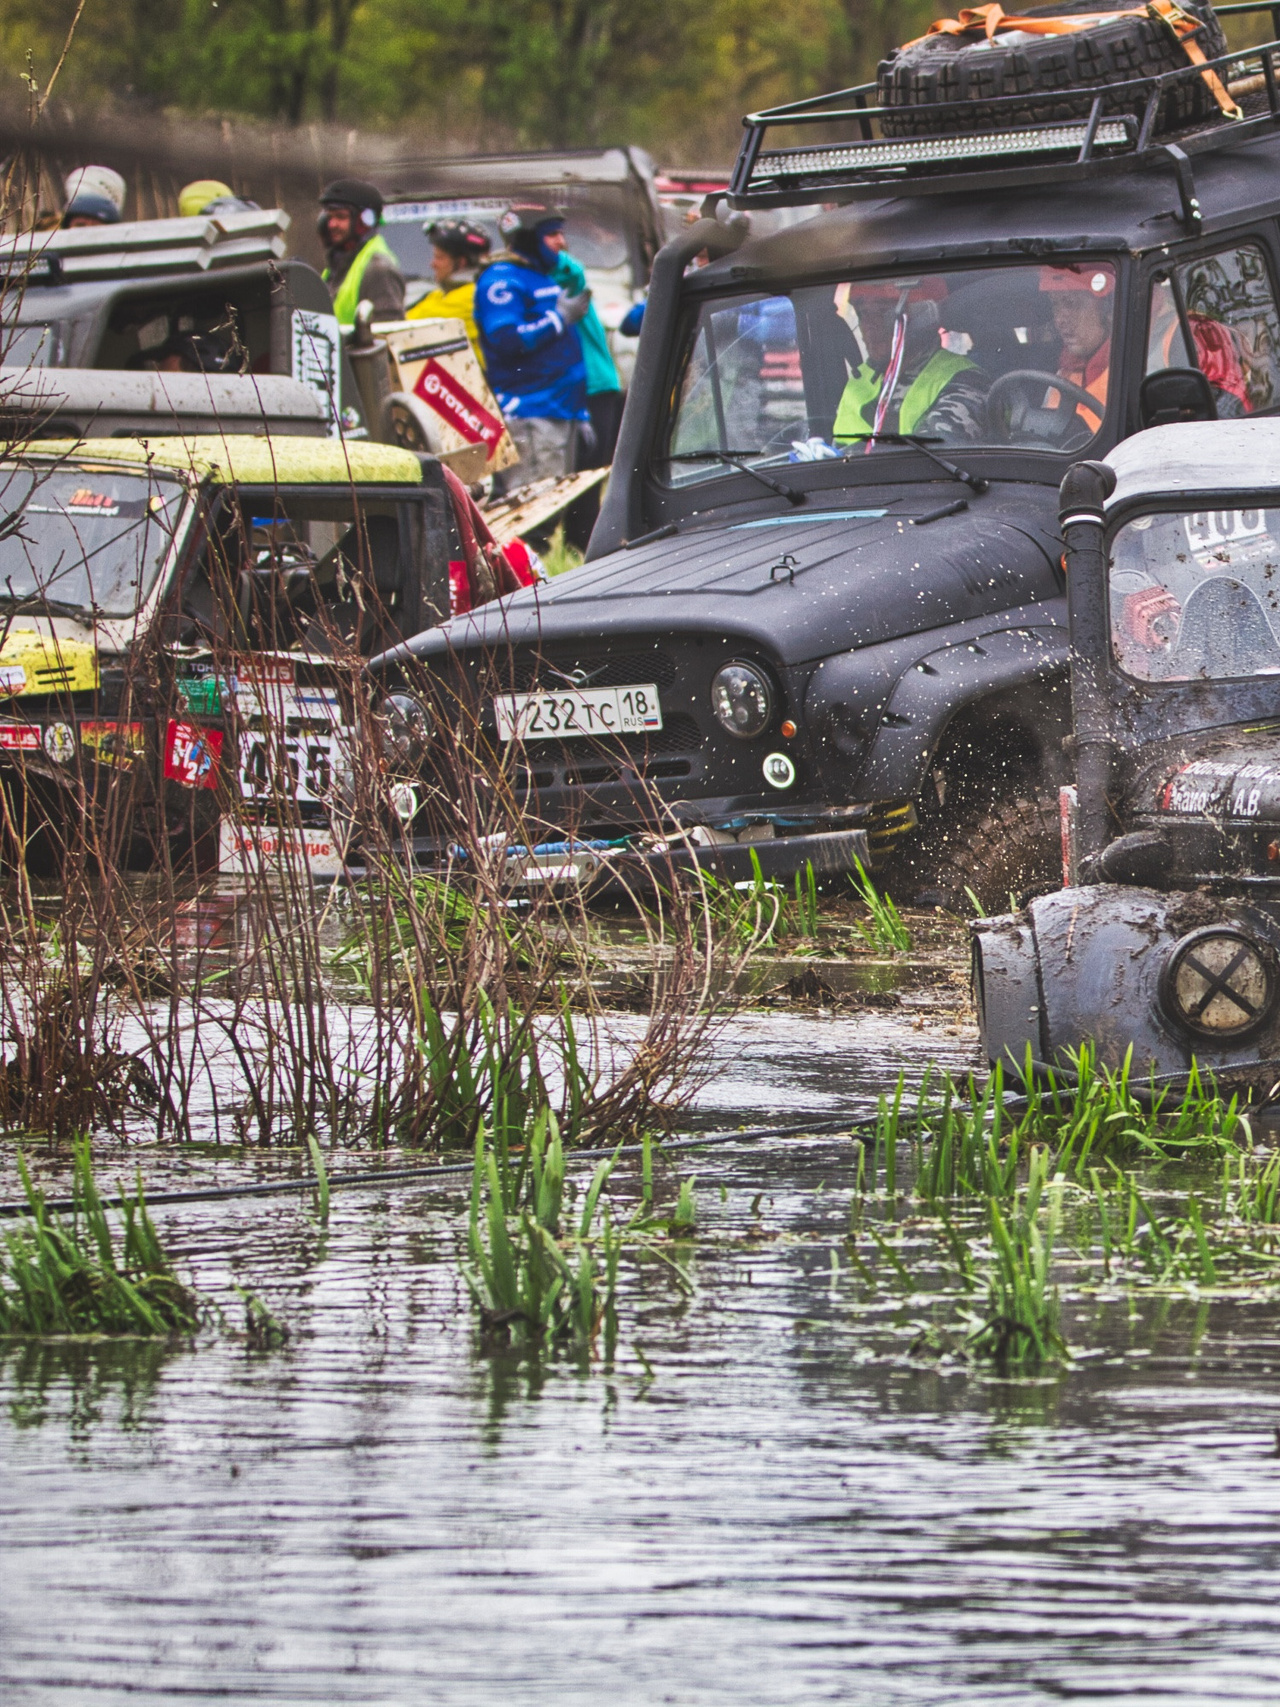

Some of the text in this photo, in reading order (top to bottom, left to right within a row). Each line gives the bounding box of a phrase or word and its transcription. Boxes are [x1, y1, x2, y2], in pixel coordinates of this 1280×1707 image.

[507, 690, 648, 734] У232ТС 18
[623, 716, 643, 727] RUS
